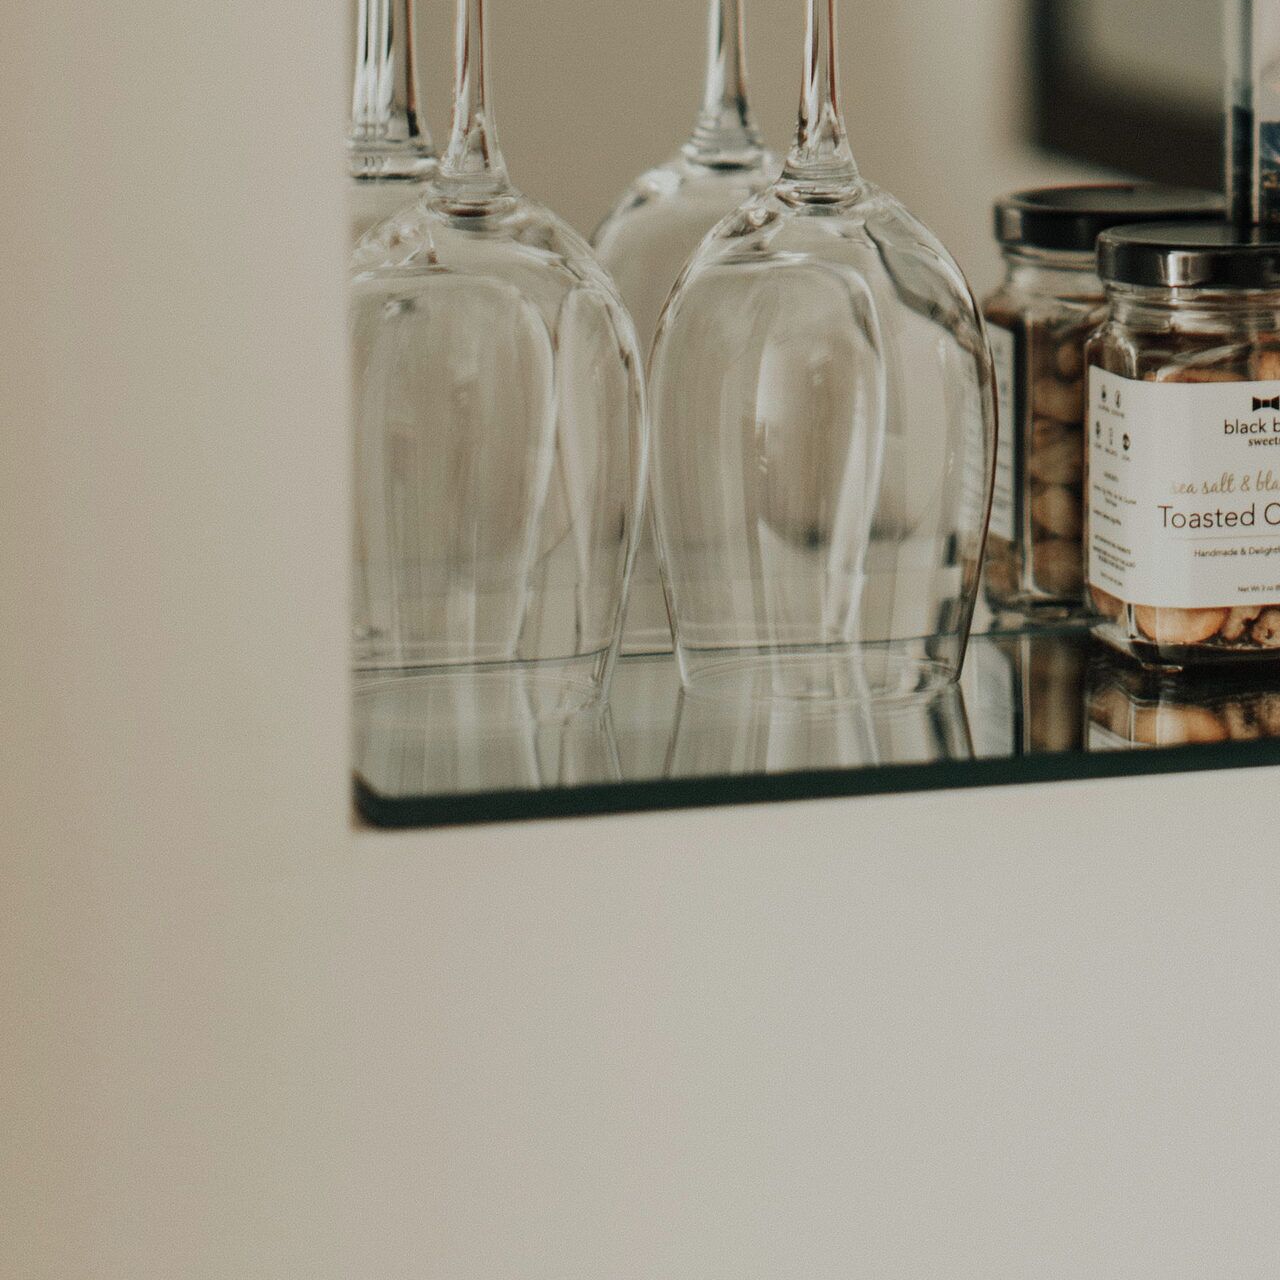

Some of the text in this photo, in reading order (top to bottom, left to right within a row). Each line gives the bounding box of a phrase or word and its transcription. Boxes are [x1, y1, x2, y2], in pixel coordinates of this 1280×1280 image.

[1224, 419, 1266, 436] black
[1202, 472, 1236, 495] salt
[1240, 474, 1251, 493] &
[1157, 502, 1256, 529] Toasted
[1194, 547, 1238, 558] Handmade
